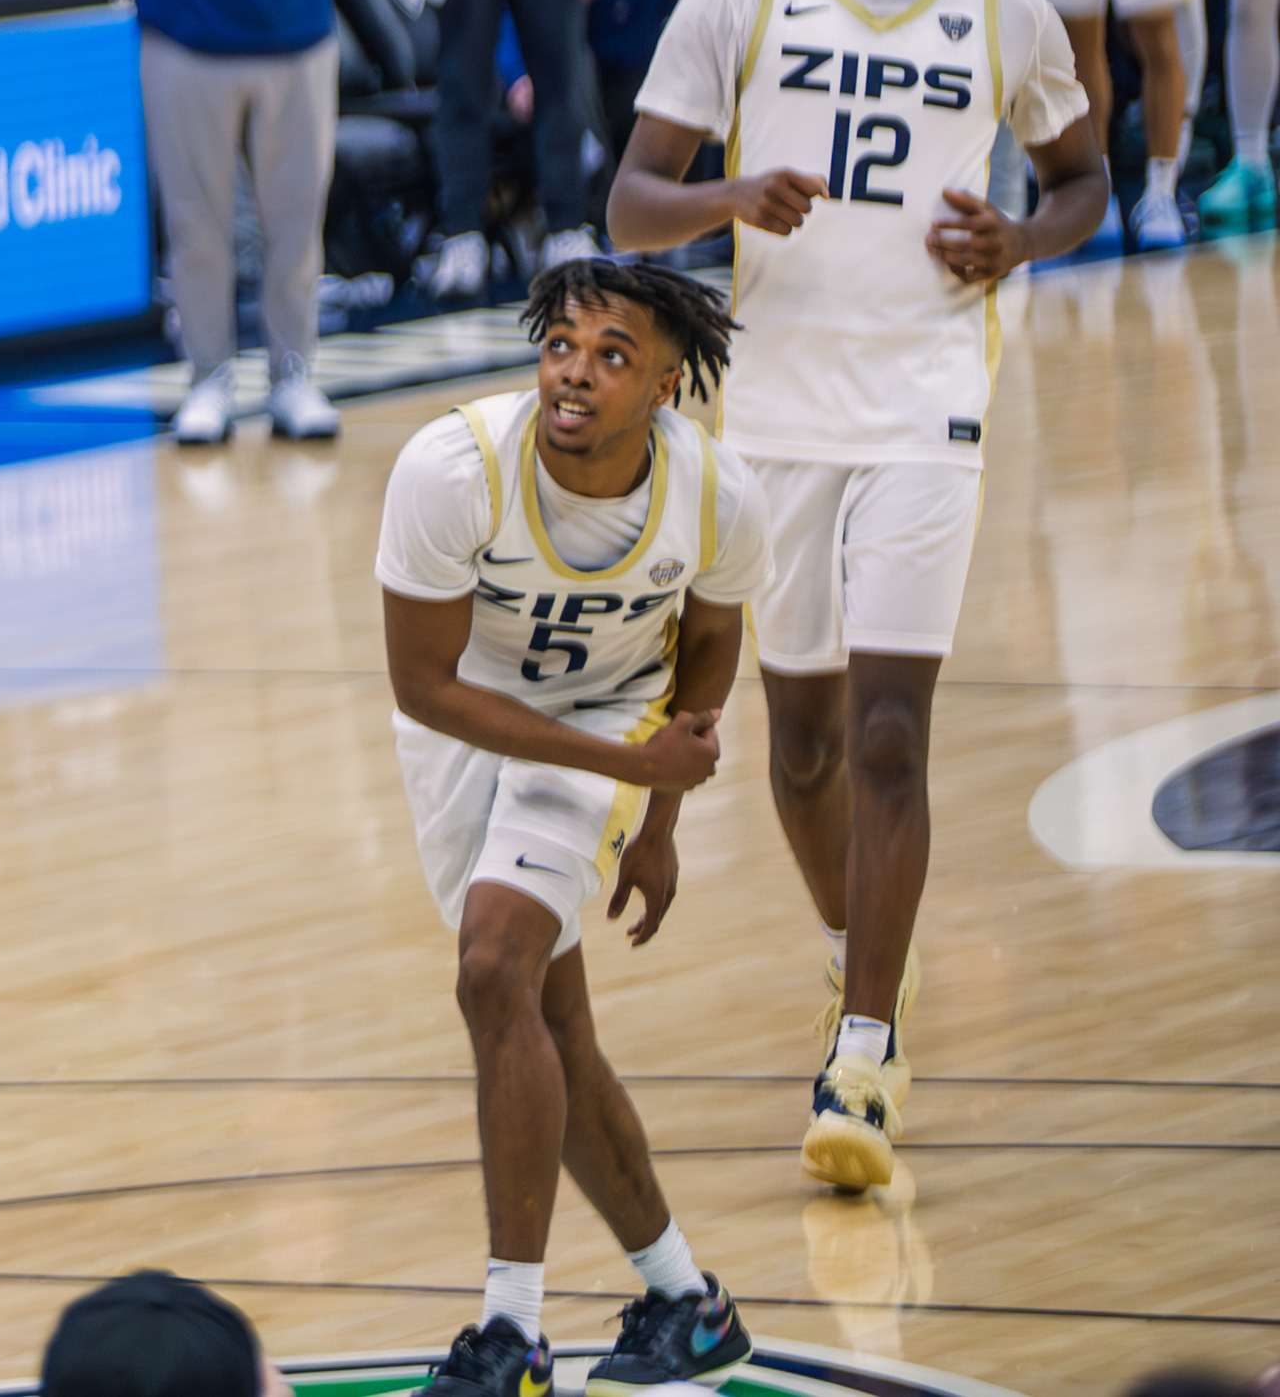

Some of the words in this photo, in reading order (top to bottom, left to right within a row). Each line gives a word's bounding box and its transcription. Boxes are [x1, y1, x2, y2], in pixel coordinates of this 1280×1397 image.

[779, 43, 973, 111] ZIPS
[11, 133, 122, 230] Clinic
[828, 107, 911, 208] 12
[474, 575, 680, 627] ZIPS
[521, 620, 594, 682] 5
